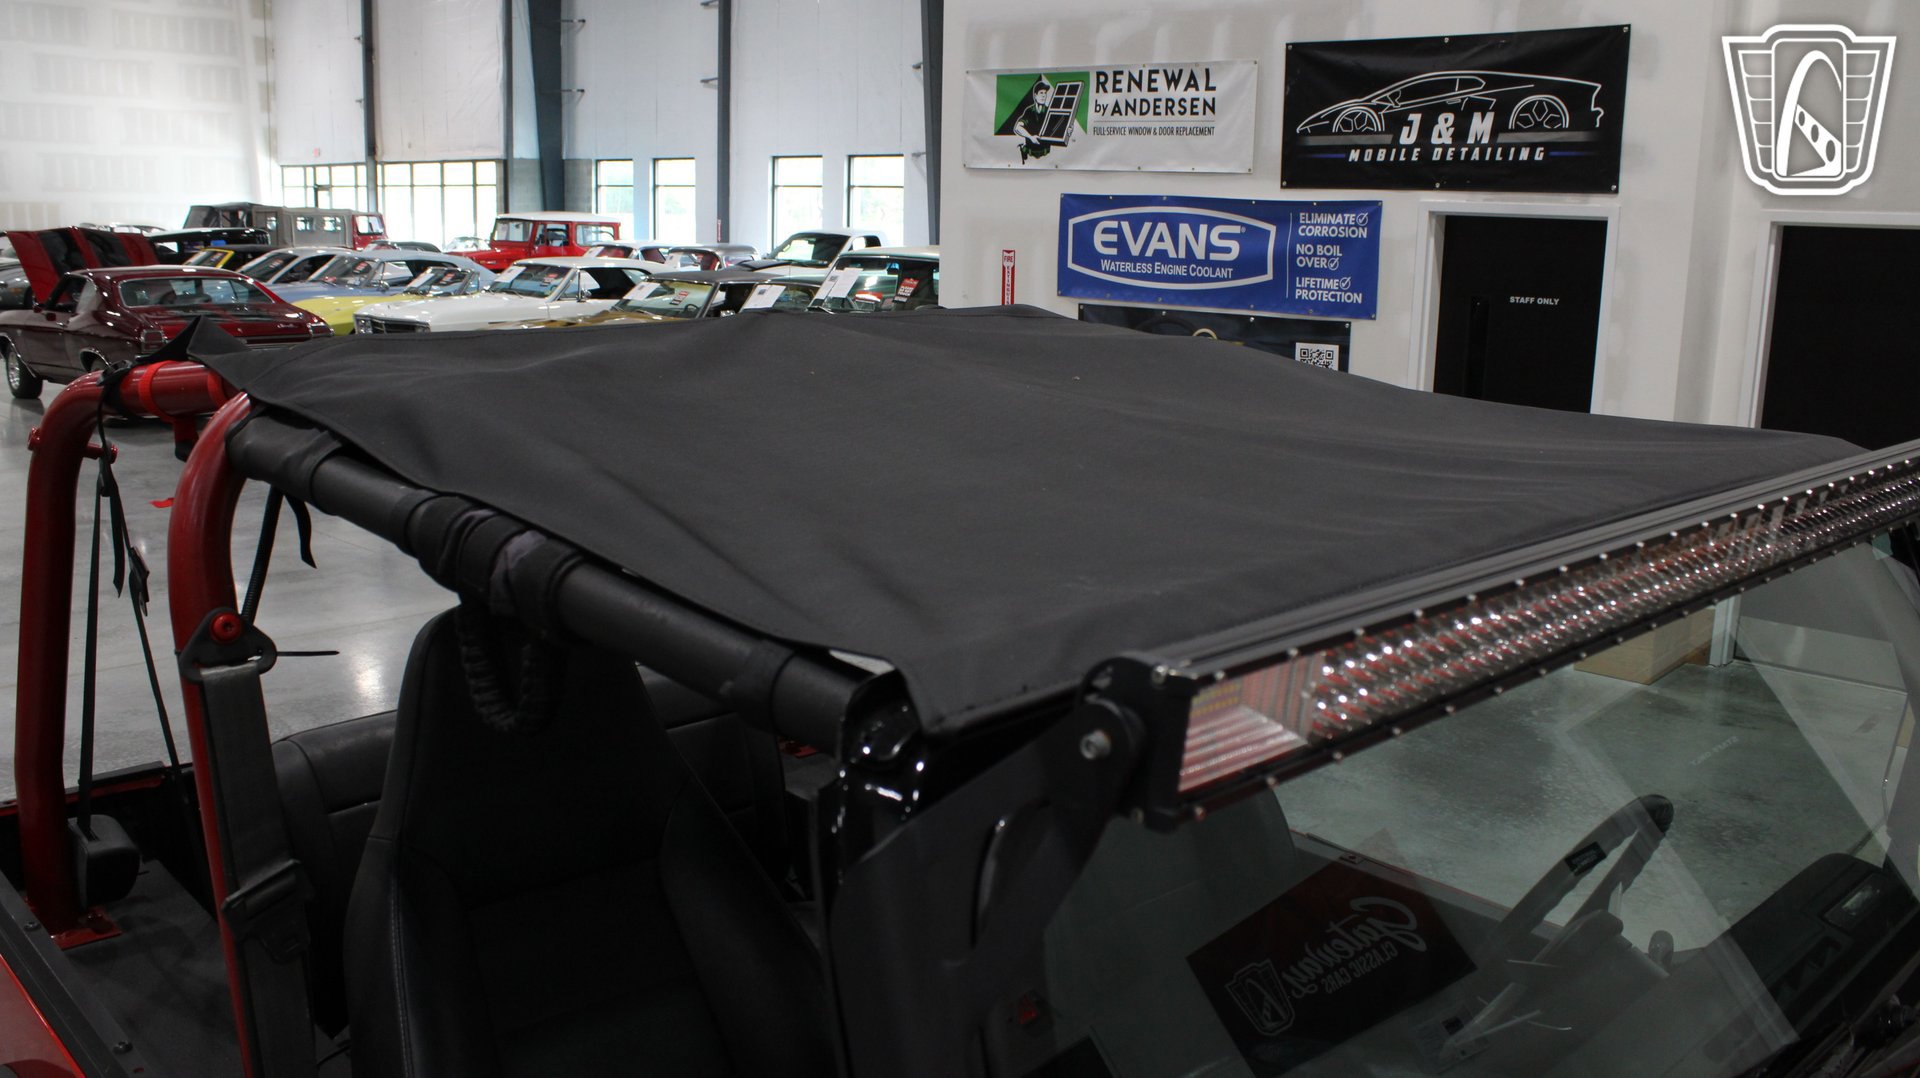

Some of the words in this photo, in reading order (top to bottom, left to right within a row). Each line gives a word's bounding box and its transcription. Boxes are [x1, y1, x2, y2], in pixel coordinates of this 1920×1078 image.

[1096, 68, 1217, 93] RENEWAL
[1094, 99, 1108, 116] by
[1111, 97, 1216, 116] ANDERSEN
[1128, 127, 1152, 136] WINDOW
[1153, 127, 1158, 136] &
[1159, 127, 1174, 136] DOOR
[1176, 127, 1215, 136] REPLACEMENT
[1399, 113, 1421, 144] J
[1431, 113, 1455, 144] &
[1467, 112, 1494, 144] M
[1349, 148, 1420, 161] MOBILE
[1432, 147, 1545, 161] DETAILING
[1299, 213, 1357, 225] ELIMINATE
[1298, 225, 1367, 238] CORROSION
[1296, 243, 1314, 255] NO
[1316, 245, 1342, 256] BOIL
[1101, 259, 1152, 273] WATERLESS
[1154, 262, 1187, 276] ENGINE
[1189, 264, 1233, 278] COOLANT
[1296, 256, 1328, 268] OVER
[1296, 277, 1339, 289] LIFETIME
[1295, 289, 1362, 304] PROTECTION
[1510, 296, 1535, 304] STAFF
